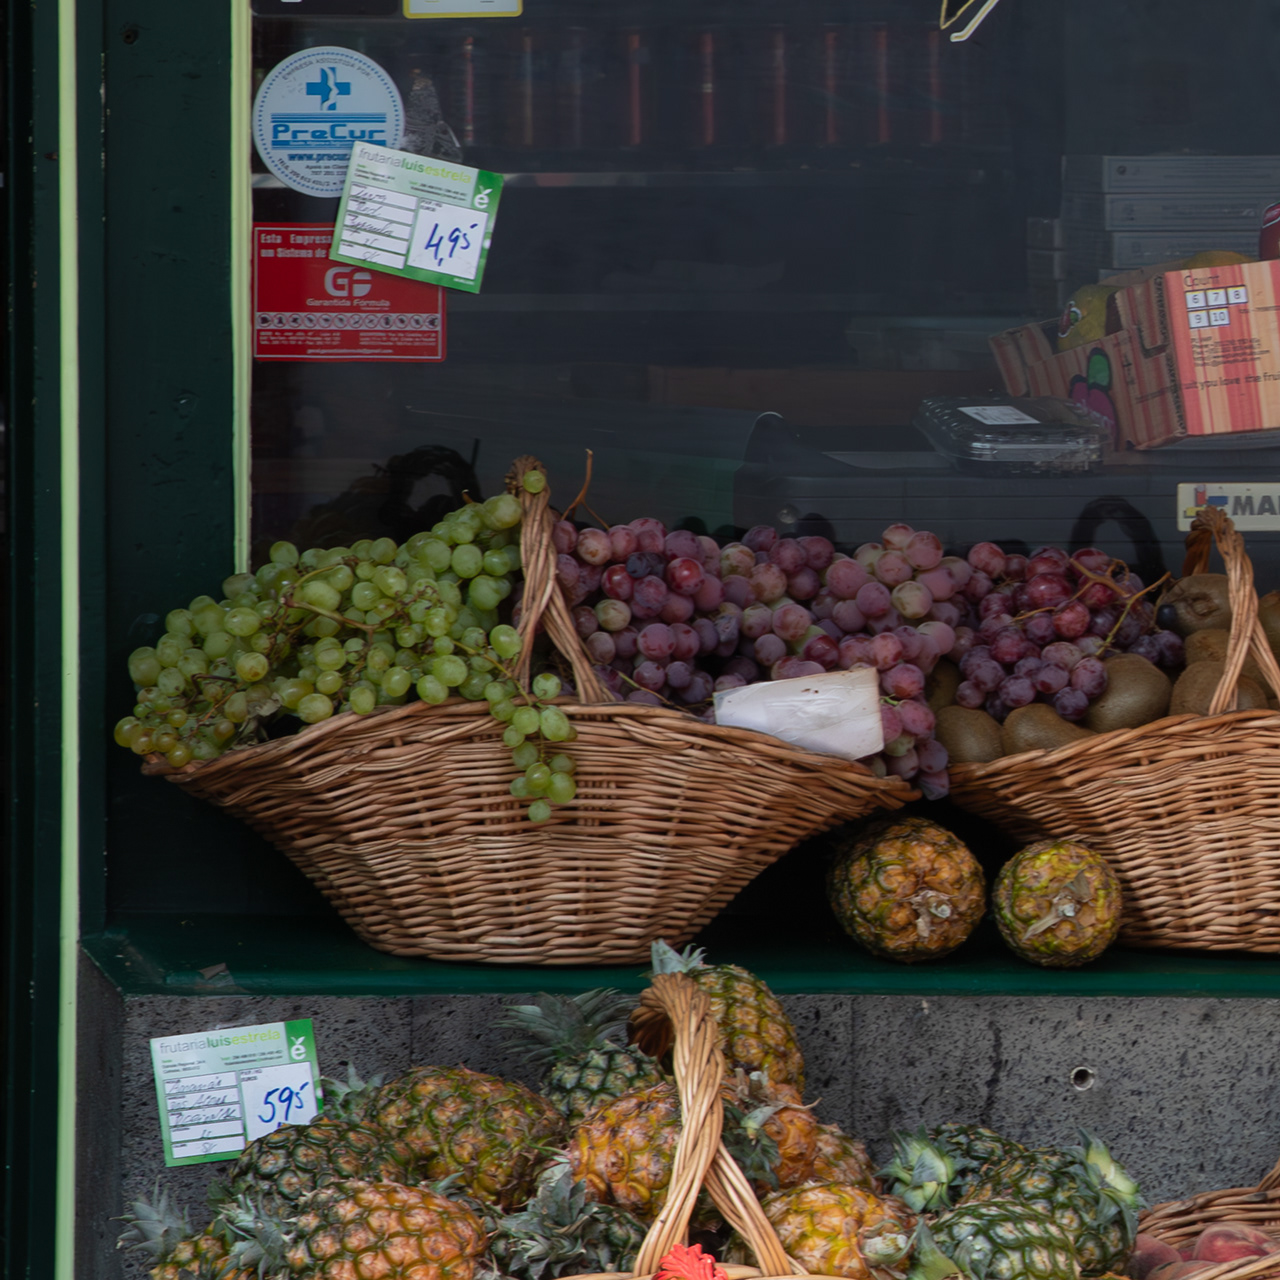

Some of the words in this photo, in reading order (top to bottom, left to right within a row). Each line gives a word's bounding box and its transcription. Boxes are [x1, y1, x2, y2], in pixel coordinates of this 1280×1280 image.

[272, 123, 386, 140] PreCur
[1184, 274, 1219, 288] Count
[1192, 294, 1200, 304] 6
[1213, 292, 1220, 302] 7
[1233, 290, 1241, 300] 8
[1213, 311, 1226, 322] 10
